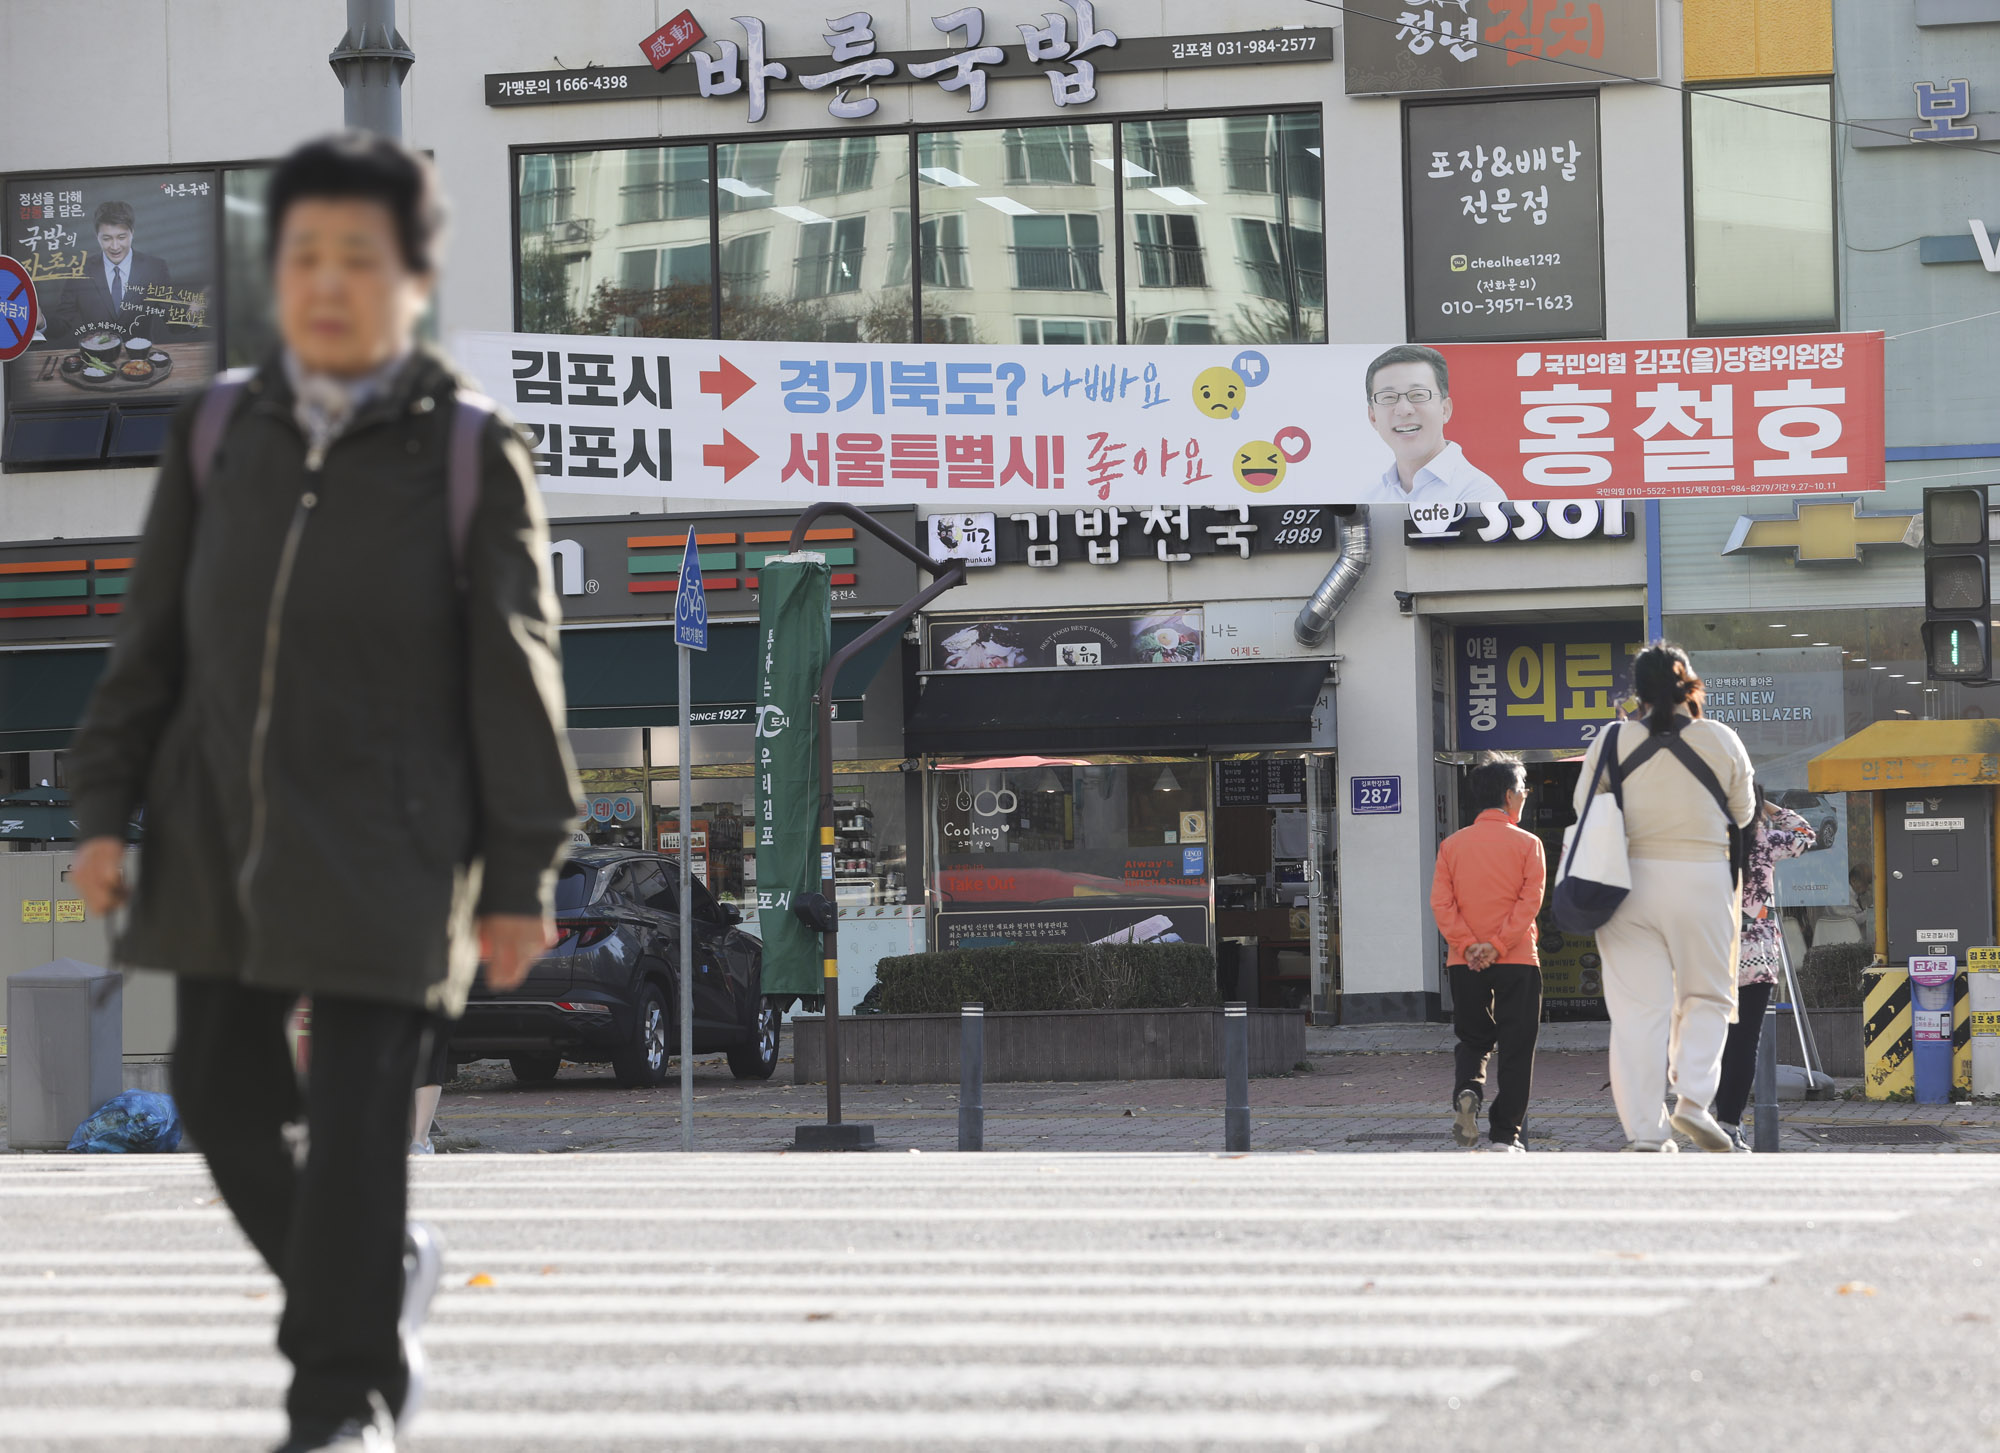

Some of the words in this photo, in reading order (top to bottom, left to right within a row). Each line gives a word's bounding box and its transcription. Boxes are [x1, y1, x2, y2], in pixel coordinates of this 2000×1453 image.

[650, 19, 695, 61] 感動
[1396, 9, 1478, 63] 청년
[1172, 41, 1213, 59] 김포점
[1218, 37, 1317, 56] 031-984-2577
[690, 0, 1119, 123] 바른국밥
[499, 79, 551, 96] 가맹문의
[555, 75, 628, 92] 1666-4398
[1909, 79, 1978, 143] 보
[1427, 140, 1582, 183] 포장&배달
[19, 191, 55, 206] 정성을
[59, 190, 82, 204] 다해
[164, 182, 210, 196] 바른국밥
[20, 205, 55, 220] 감동을
[59, 204, 85, 218] 담은,
[1460, 184, 1549, 226] 전문점
[19, 224, 77, 252] 국밥의
[1470, 253, 1561, 269] cheolhee1292
[147, 283, 174, 300] 최고급
[1441, 295, 1574, 315] 010-3957-1623
[74, 325, 87, 336] 이런
[1545, 352, 1626, 375] 국민의힘
[1634, 343, 1845, 375] 김포(을)당협위원장
[511, 350, 672, 410] 김포시
[779, 360, 1026, 416] 경기북도?
[1041, 361, 1171, 410] 나빠요
[1519, 378, 1848, 486] 홍철호
[514, 423, 672, 481] 김포시
[781, 433, 1064, 489] 서울특별시!
[1087, 431, 1212, 501] 좋아요
[1596, 488, 1625, 497] 국민의힘
[1280, 508, 1320, 526] 997
[962, 518, 992, 553] 유로
[1010, 504, 1258, 567] 김밥천국
[1273, 527, 1323, 545] 4989
[681, 626, 703, 644] 자전거횡단
[1040, 635, 1053, 651] BEST
[1053, 627, 1070, 638] FOOD
[1089, 627, 1118, 649] DELICIOUS
[1212, 624, 1238, 637] 나는
[1230, 647, 1261, 656] 어제도
[1466, 637, 1497, 660] 이원
[1507, 643, 1642, 722] 의료
[1705, 679, 1712, 687] 더
[1716, 678, 1746, 687] 완벽하게
[1750, 677, 1773, 686] 돌아온
[1469, 665, 1497, 731] 보경
[1706, 692, 1735, 705] THE
[1740, 691, 1775, 705] NEW
[689, 711, 717, 721] SINCE
[718, 709, 747, 720] 1927
[1706, 707, 1812, 722] TRAILBLAZER
[1361, 788, 1392, 804] 287
[944, 822, 999, 840] Cooking
[1125, 870, 1160, 878] ENJOY
[947, 877, 985, 891] Take
[987, 876, 1016, 890] Out
[1920, 932, 1954, 940] 김포경찰서장
[1969, 951, 2000, 960] 김포생
[1971, 1015, 2000, 1024] 김포생
